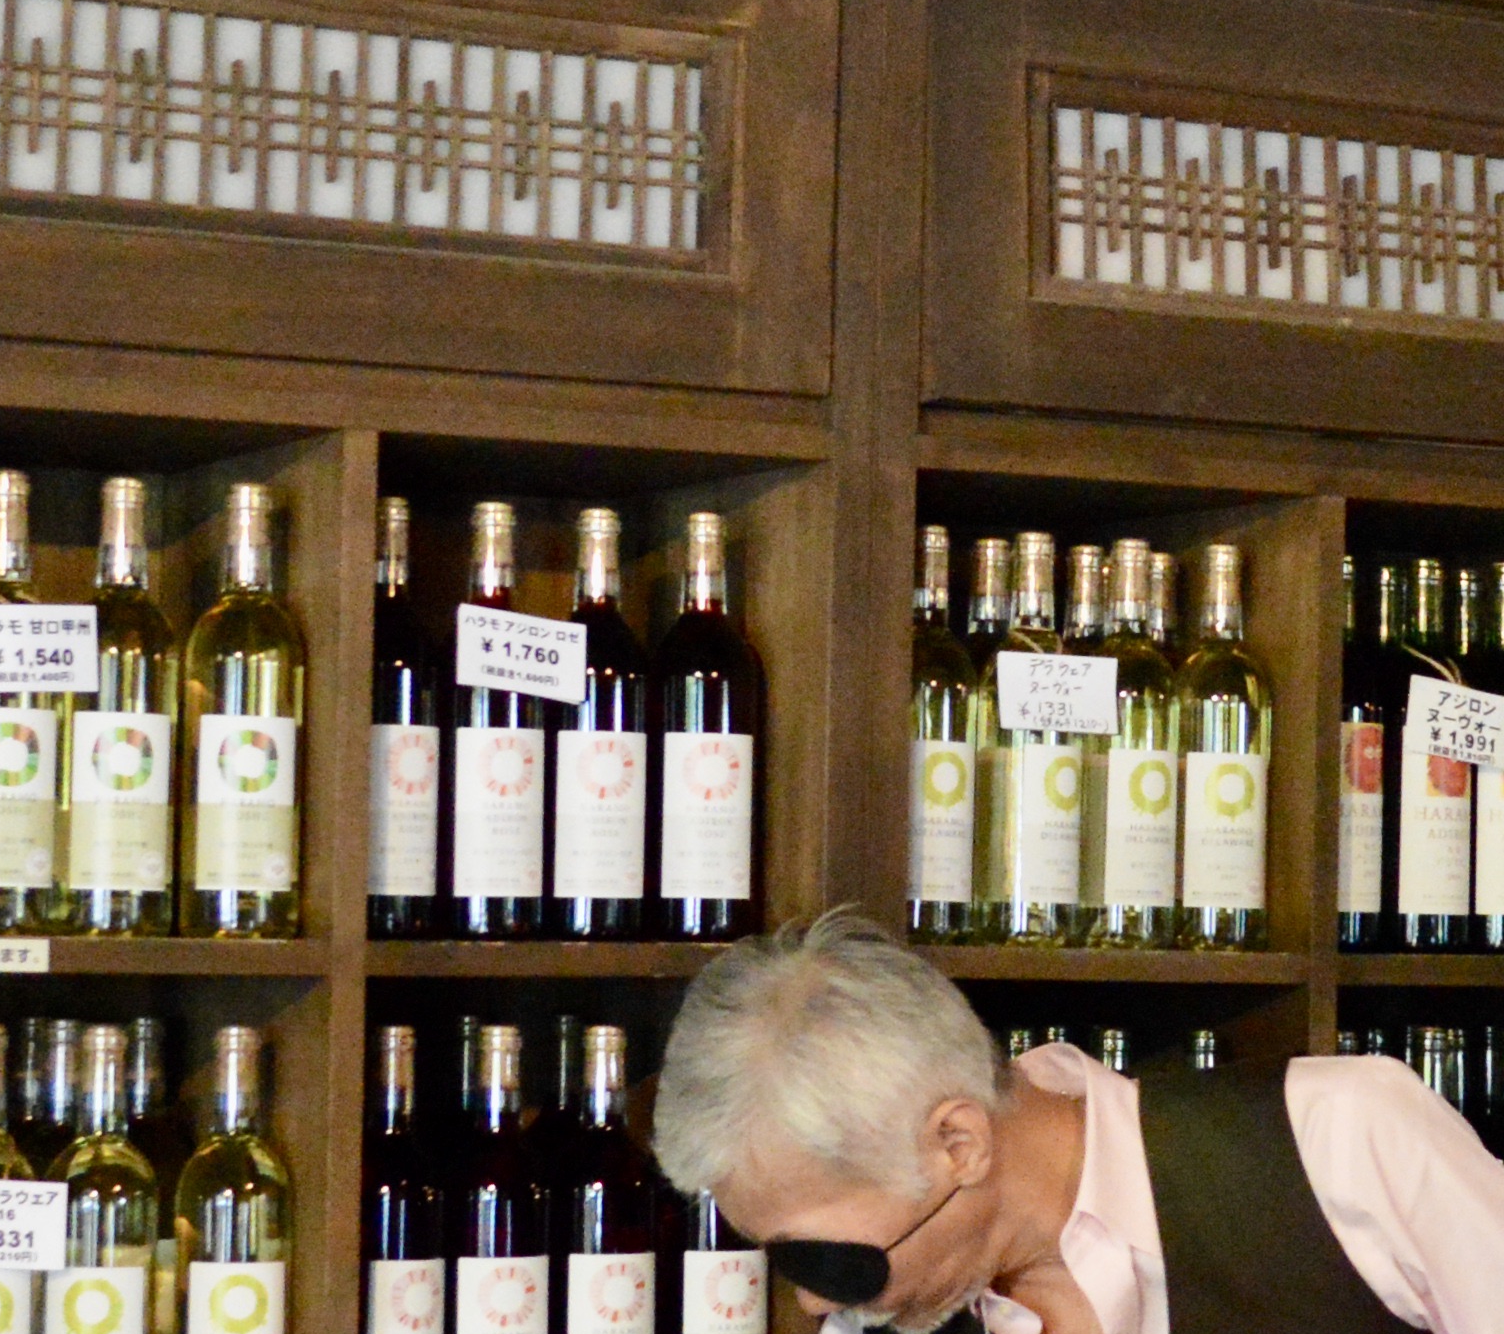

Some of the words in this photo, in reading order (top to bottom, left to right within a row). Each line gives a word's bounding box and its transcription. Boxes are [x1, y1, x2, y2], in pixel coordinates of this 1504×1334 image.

[464, 615, 500, 632] ハラモ
[15, 649, 74, 668] 1,540
[503, 641, 560, 665] 1,760
[1439, 691, 1496, 715] アジロン
[1427, 709, 1502, 732] ヌーヴォー
[1448, 731, 1496, 752] 1,991
